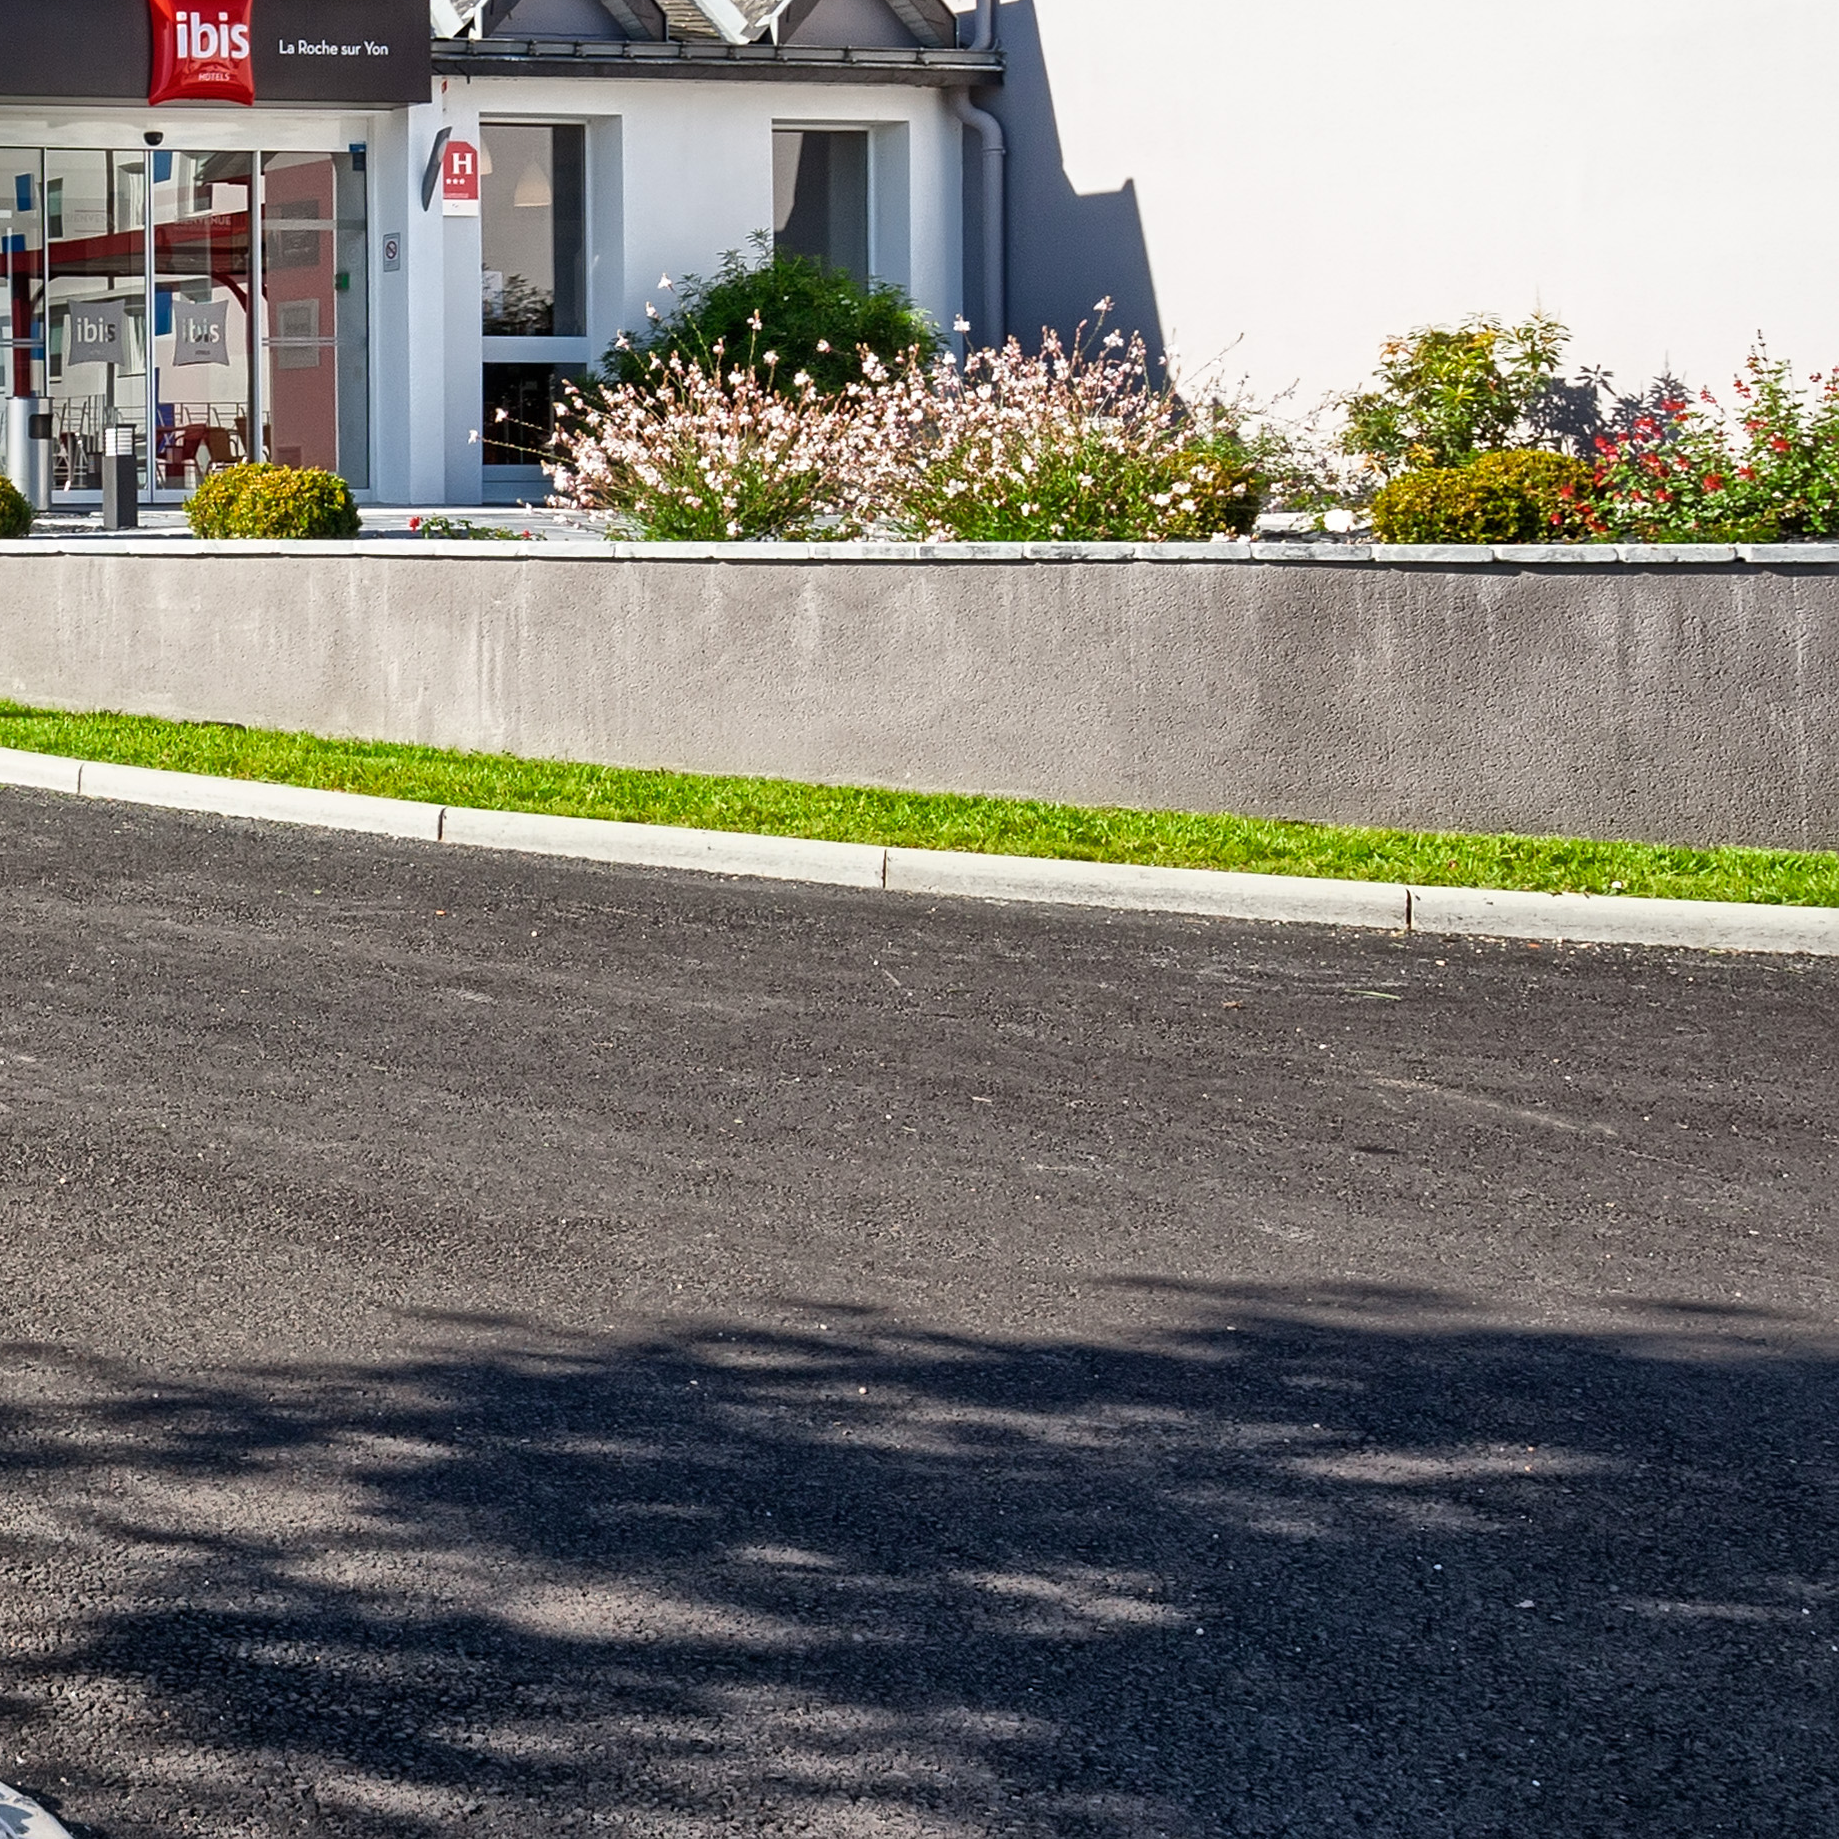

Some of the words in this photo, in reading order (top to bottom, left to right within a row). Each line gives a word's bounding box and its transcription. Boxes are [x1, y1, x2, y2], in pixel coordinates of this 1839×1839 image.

[176, 11, 250, 59] ibis
[279, 39, 295, 54] La
[298, 39, 338, 55] Roche
[341, 45, 361, 55] sur
[364, 41, 388, 55] Yon
[199, 72, 230, 81] HOTELS
[452, 152, 474, 174] H
[77, 317, 116, 343] ibis
[182, 318, 220, 343] ibis
